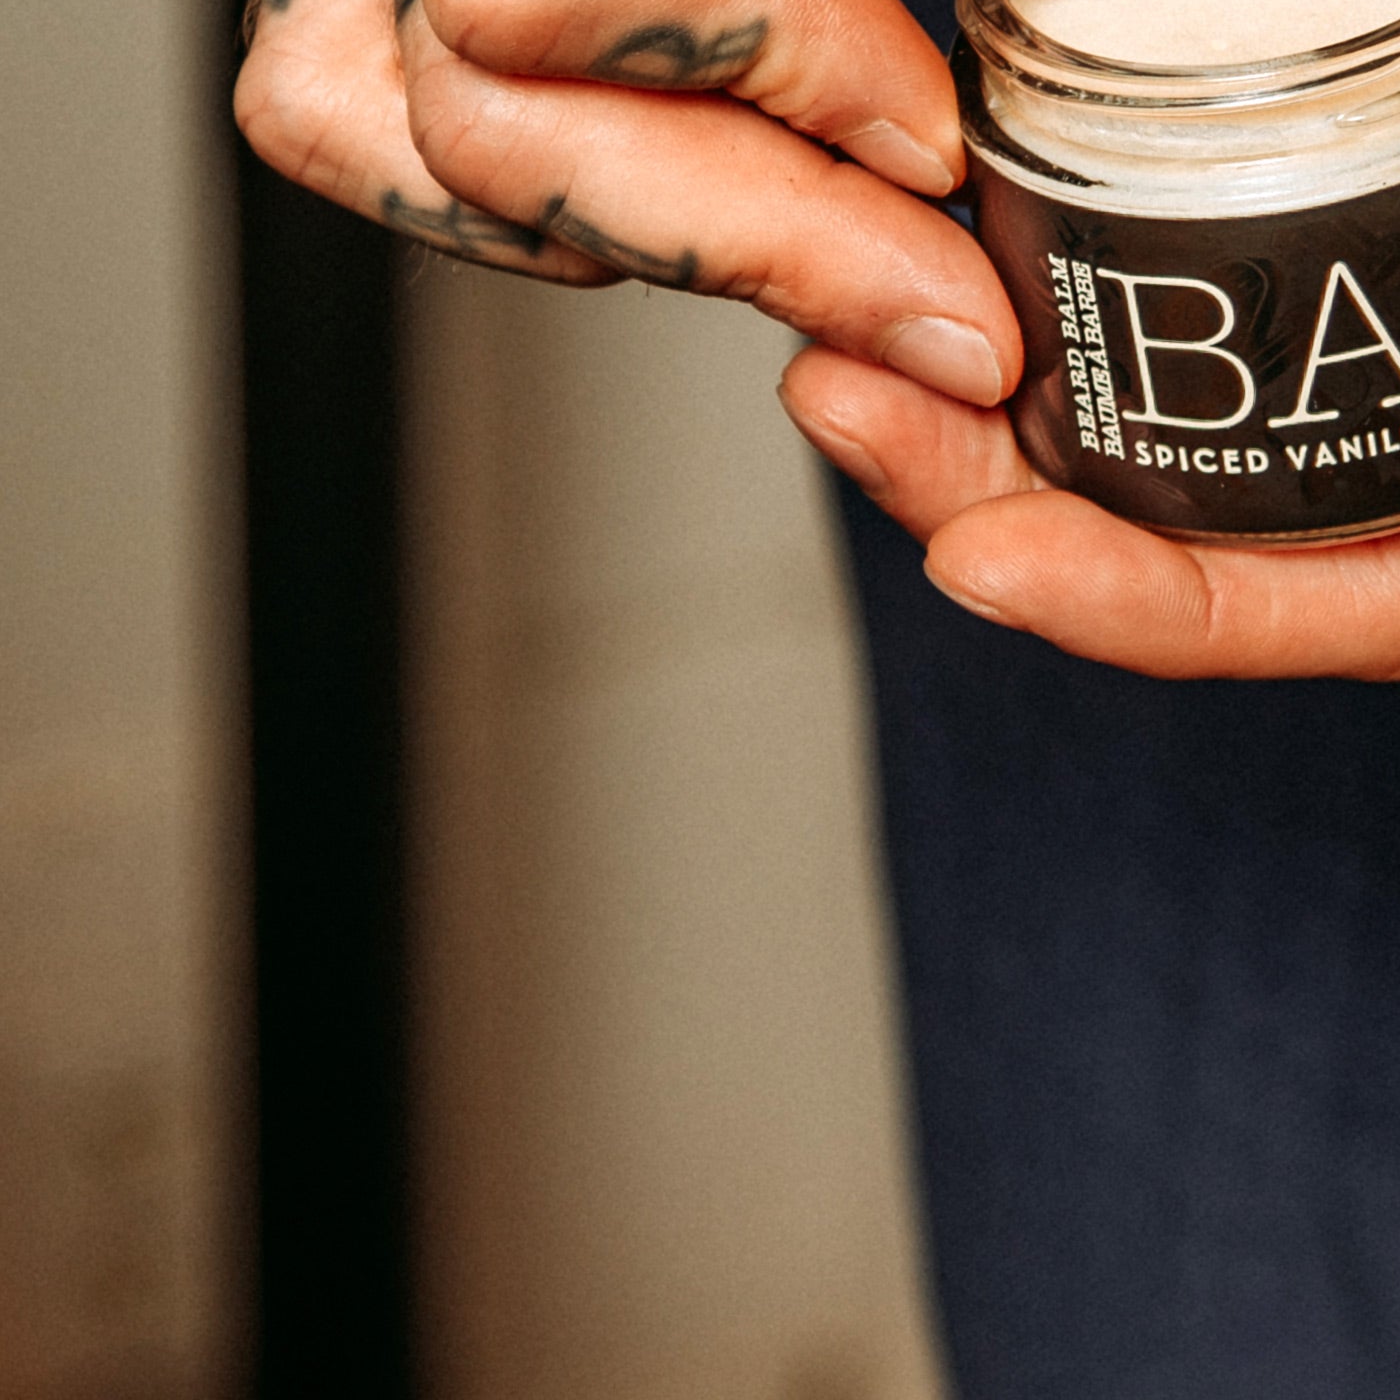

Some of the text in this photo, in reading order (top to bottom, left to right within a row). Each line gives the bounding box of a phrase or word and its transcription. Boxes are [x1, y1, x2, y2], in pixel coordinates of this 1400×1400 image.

[1072, 260, 1104, 348] BARBE
[1048, 252, 1100, 453] BEARD BALM
[1091, 365, 1125, 461] BAUME
[1135, 441, 1270, 475] SPICED
